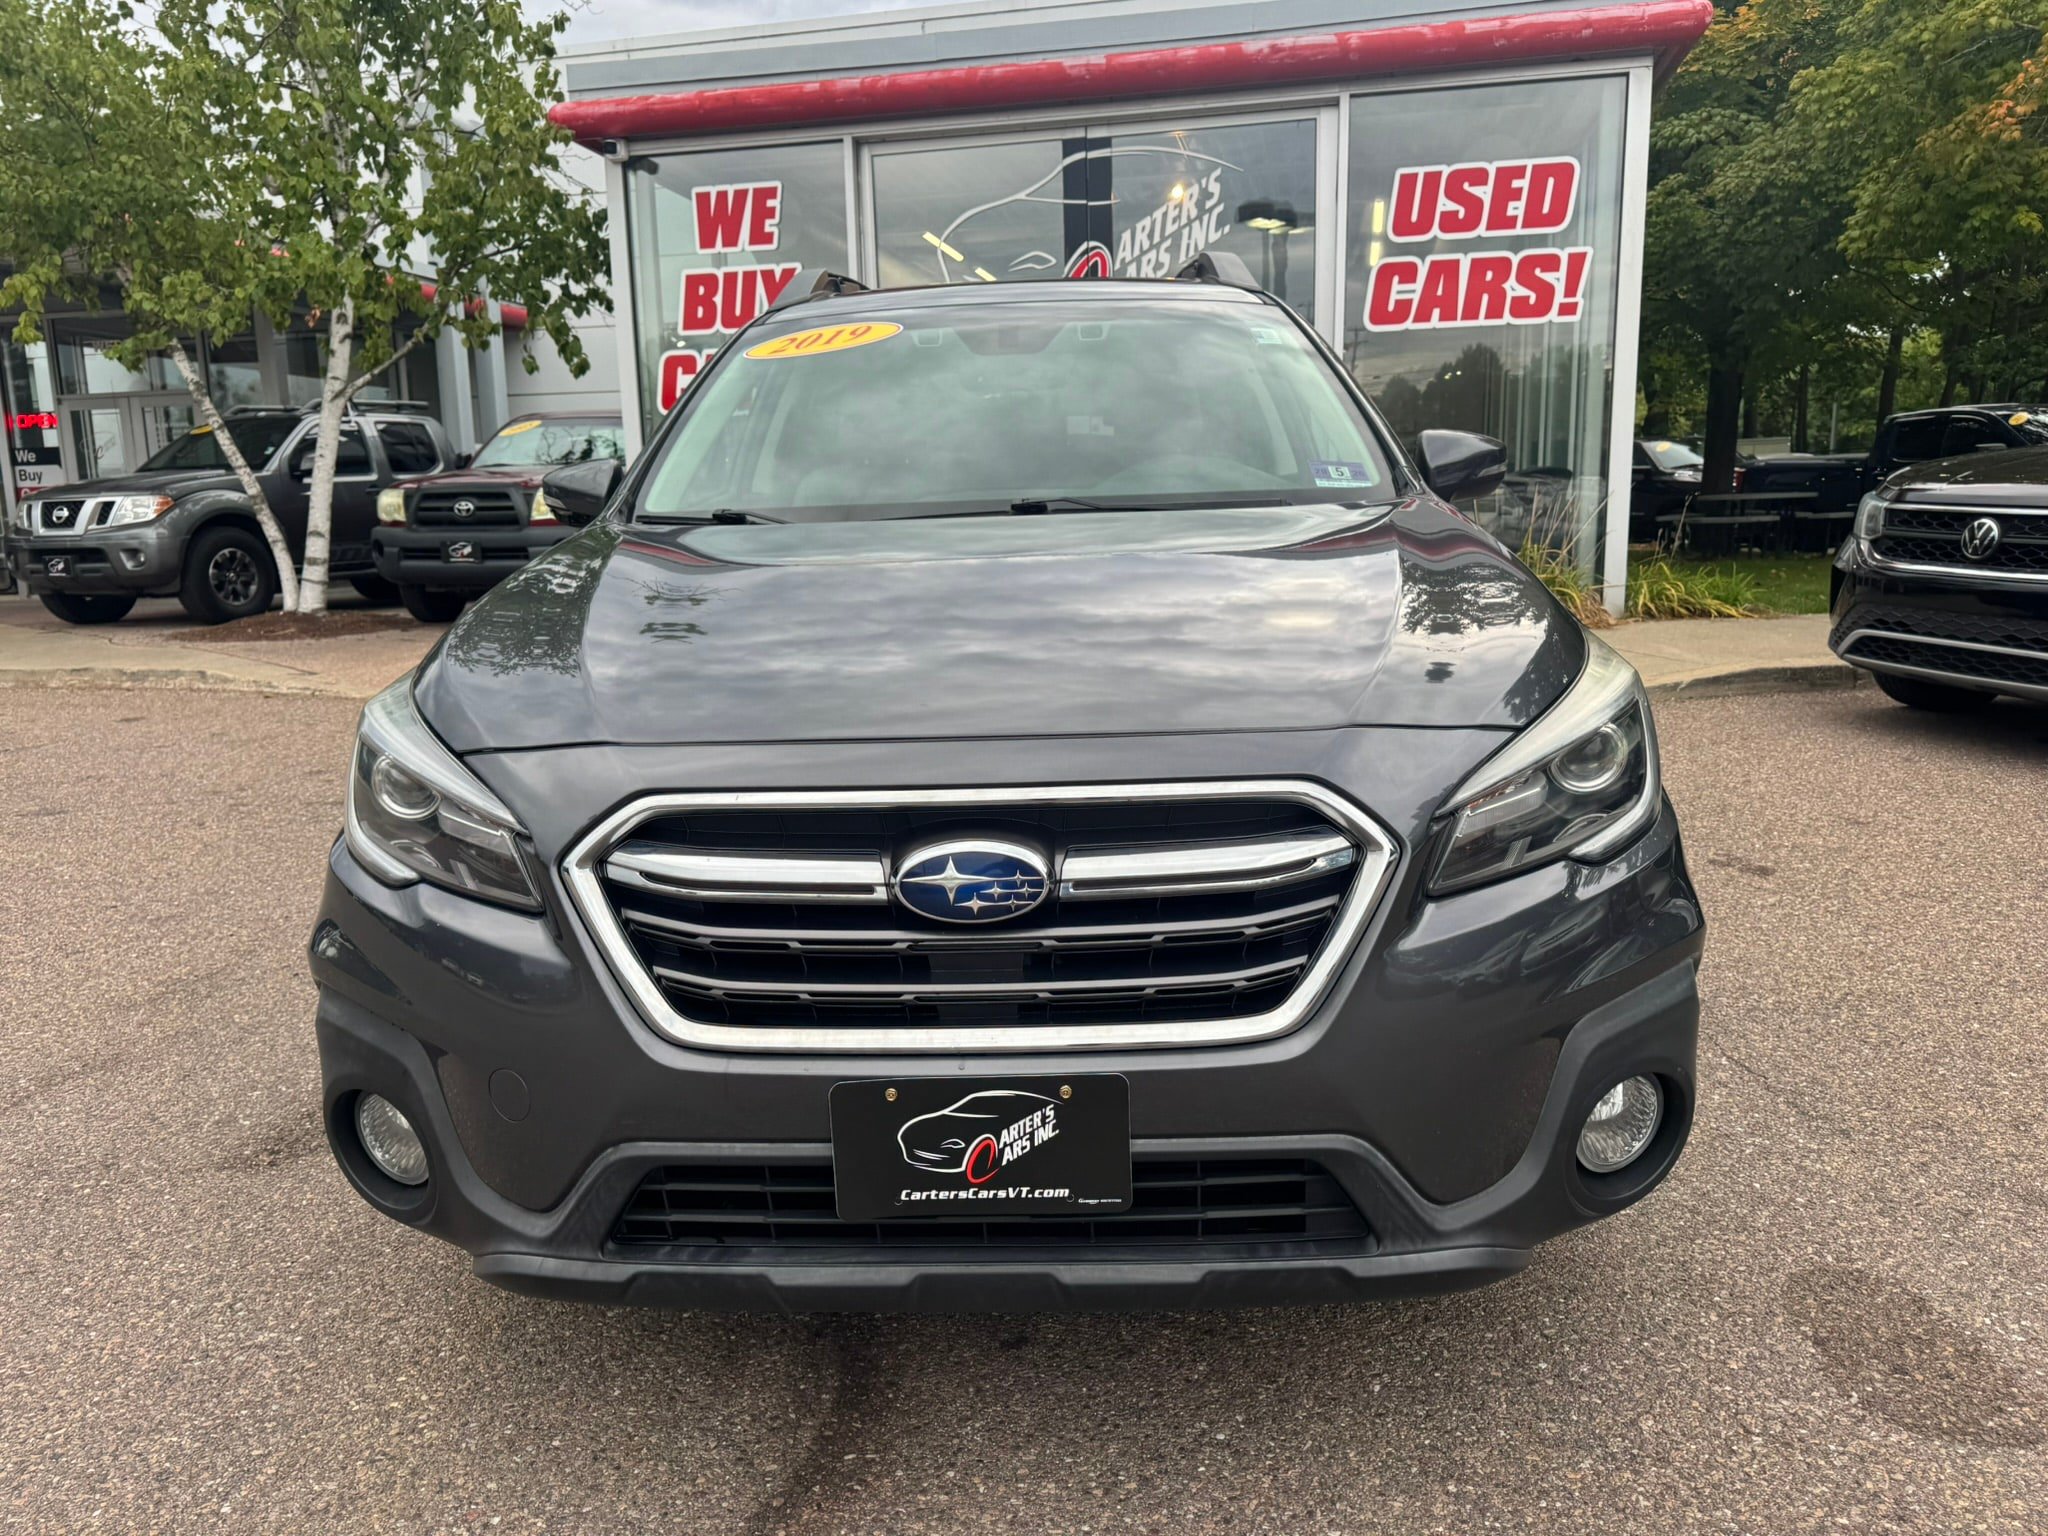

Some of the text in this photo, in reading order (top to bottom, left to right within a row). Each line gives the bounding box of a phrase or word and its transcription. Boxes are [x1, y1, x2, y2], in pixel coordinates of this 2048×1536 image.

[1391, 161, 1576, 237] USED
[694, 185, 779, 250] WE
[682, 266, 798, 331] BUY
[1368, 251, 1589, 326] CARS!
[767, 325, 872, 355] 2019
[16, 413, 58, 429] OPEN
[14, 449, 37, 463] We
[18, 469, 43, 484] Buy
[1335, 467, 1345, 477] 5
[900, 1186, 1069, 1200] CartersCarsVT.com
